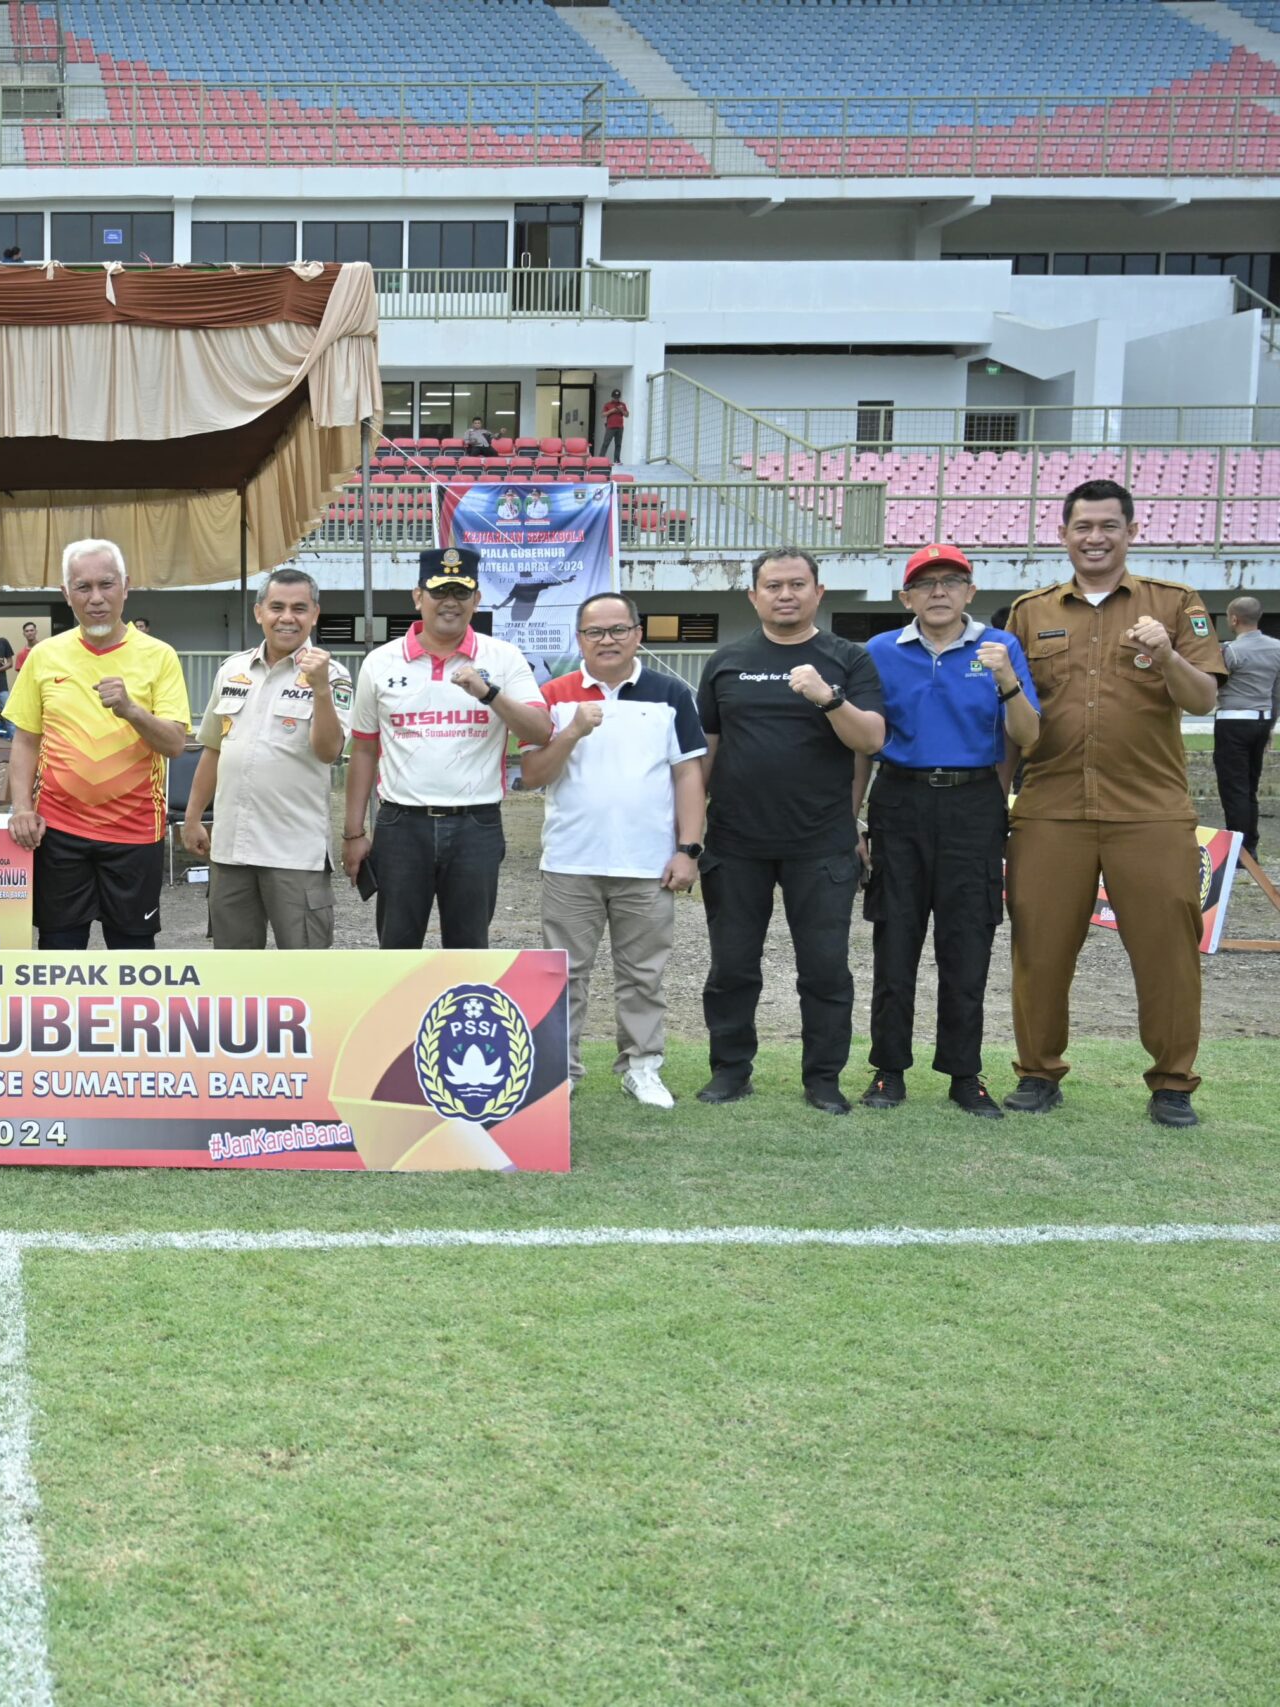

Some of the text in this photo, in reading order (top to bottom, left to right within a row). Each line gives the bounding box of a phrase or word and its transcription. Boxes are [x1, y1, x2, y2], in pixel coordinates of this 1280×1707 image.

[480, 548, 508, 559] PIALA
[517, 561, 549, 573] BARAT
[557, 560, 584, 572] 2024
[739, 672, 768, 682] Google
[769, 673, 781, 681] for
[221, 686, 249, 697] IRWAN
[389, 710, 490, 728] DISHUB
[15, 965, 108, 986] SEPAK
[119, 965, 201, 986] BOLA
[450, 1021, 497, 1039] PSSI
[32, 1071, 197, 1098] SUMATERA
[208, 1071, 308, 1098] BARAT
[209, 1121, 354, 1161] #JanKarehBana
